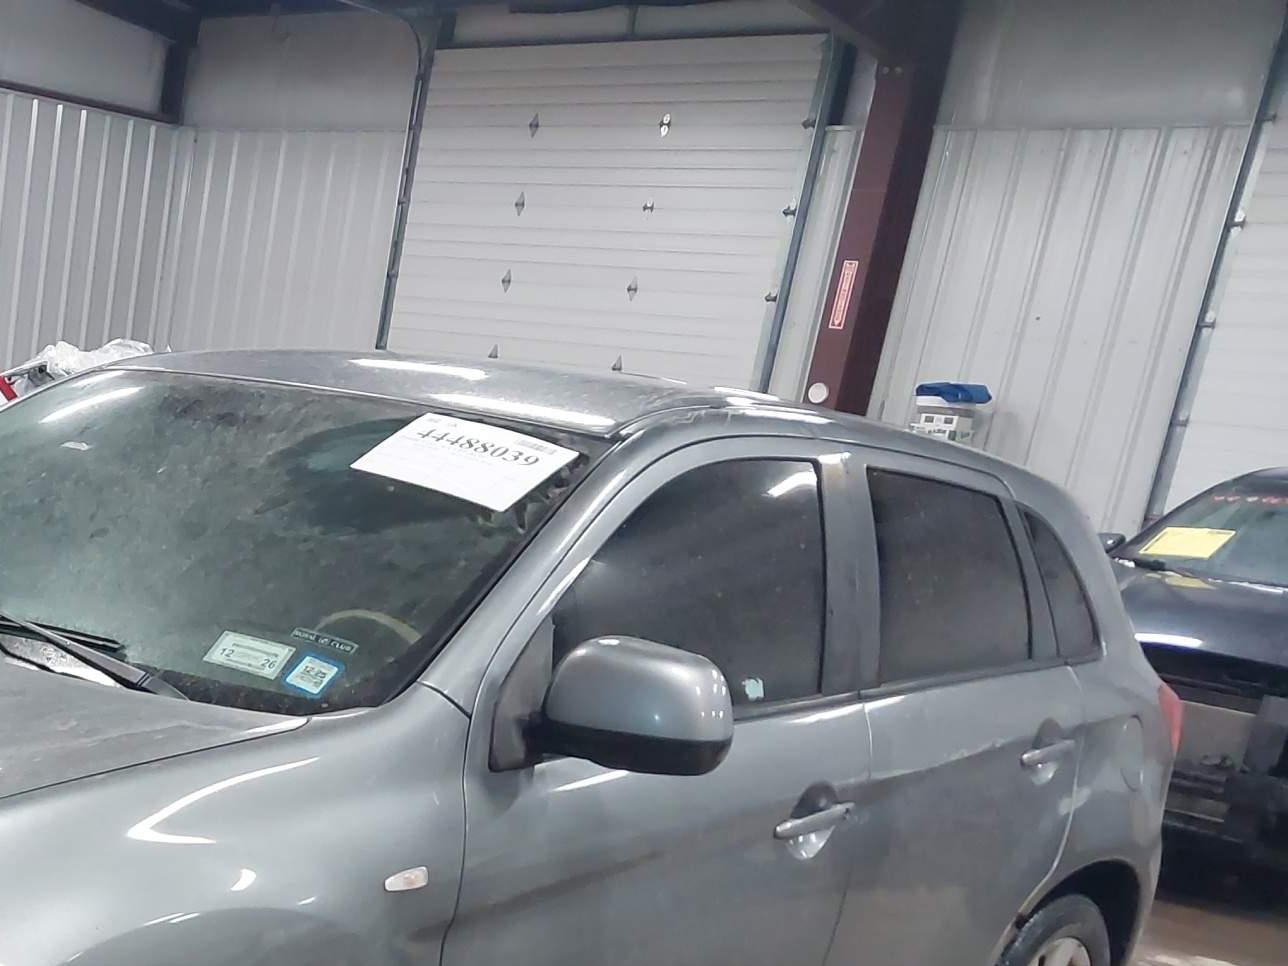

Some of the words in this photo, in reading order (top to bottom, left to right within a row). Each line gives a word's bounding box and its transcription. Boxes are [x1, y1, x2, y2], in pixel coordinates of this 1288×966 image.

[416, 428, 540, 466] 44488039
[219, 647, 235, 658] 12
[260, 658, 276, 669] 26
